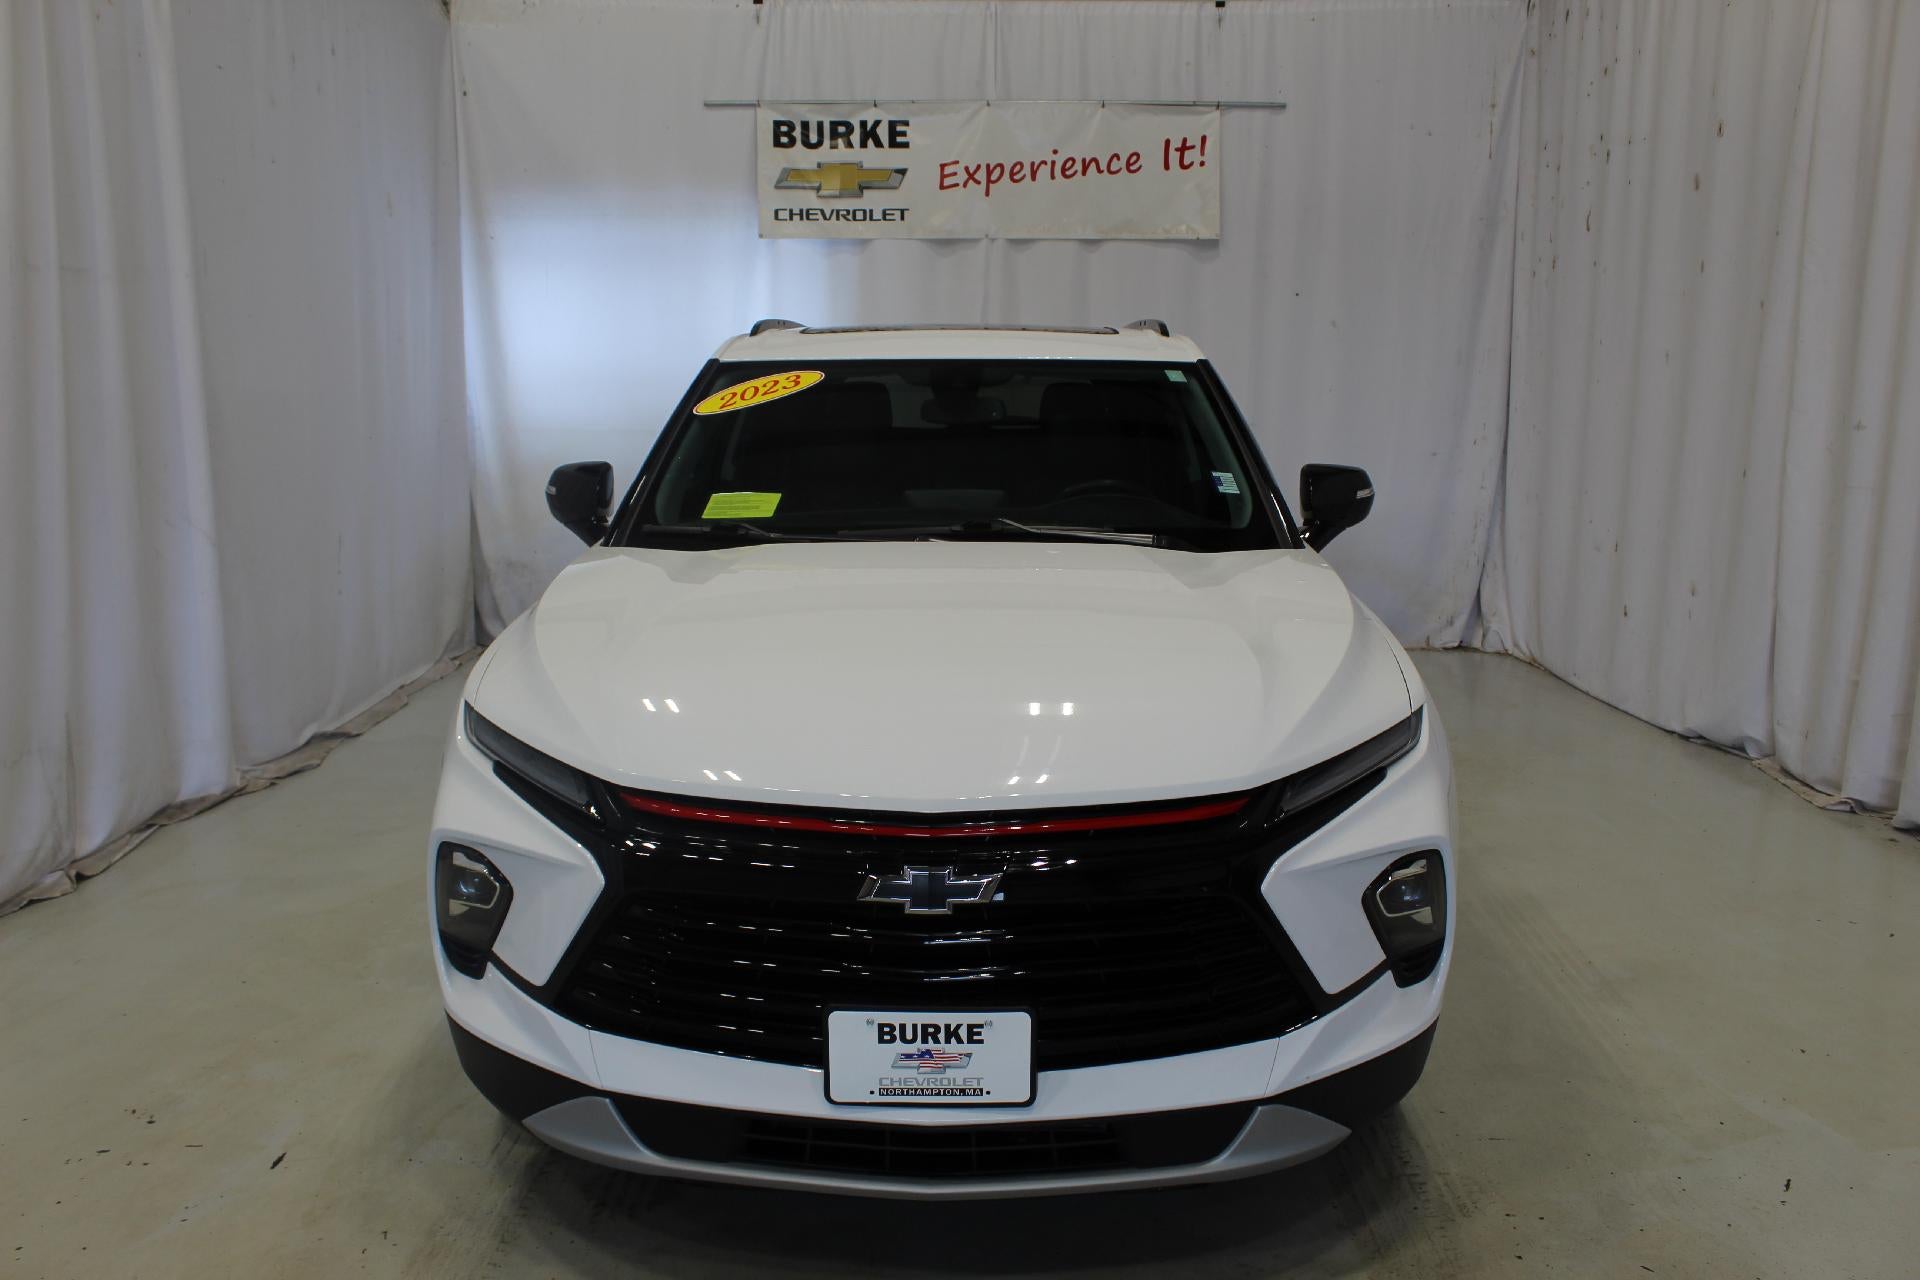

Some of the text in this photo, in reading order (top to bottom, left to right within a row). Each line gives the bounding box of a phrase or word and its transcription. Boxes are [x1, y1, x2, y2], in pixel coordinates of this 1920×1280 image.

[773, 119, 910, 150] BURKE
[938, 135, 1208, 197] Experience It!
[774, 208, 910, 222] CHEVROLET
[719, 375, 801, 409] 2023
[879, 1077, 984, 1087] CHEVROLET
[880, 1088, 982, 1096] NORTHAMPTON, MA
